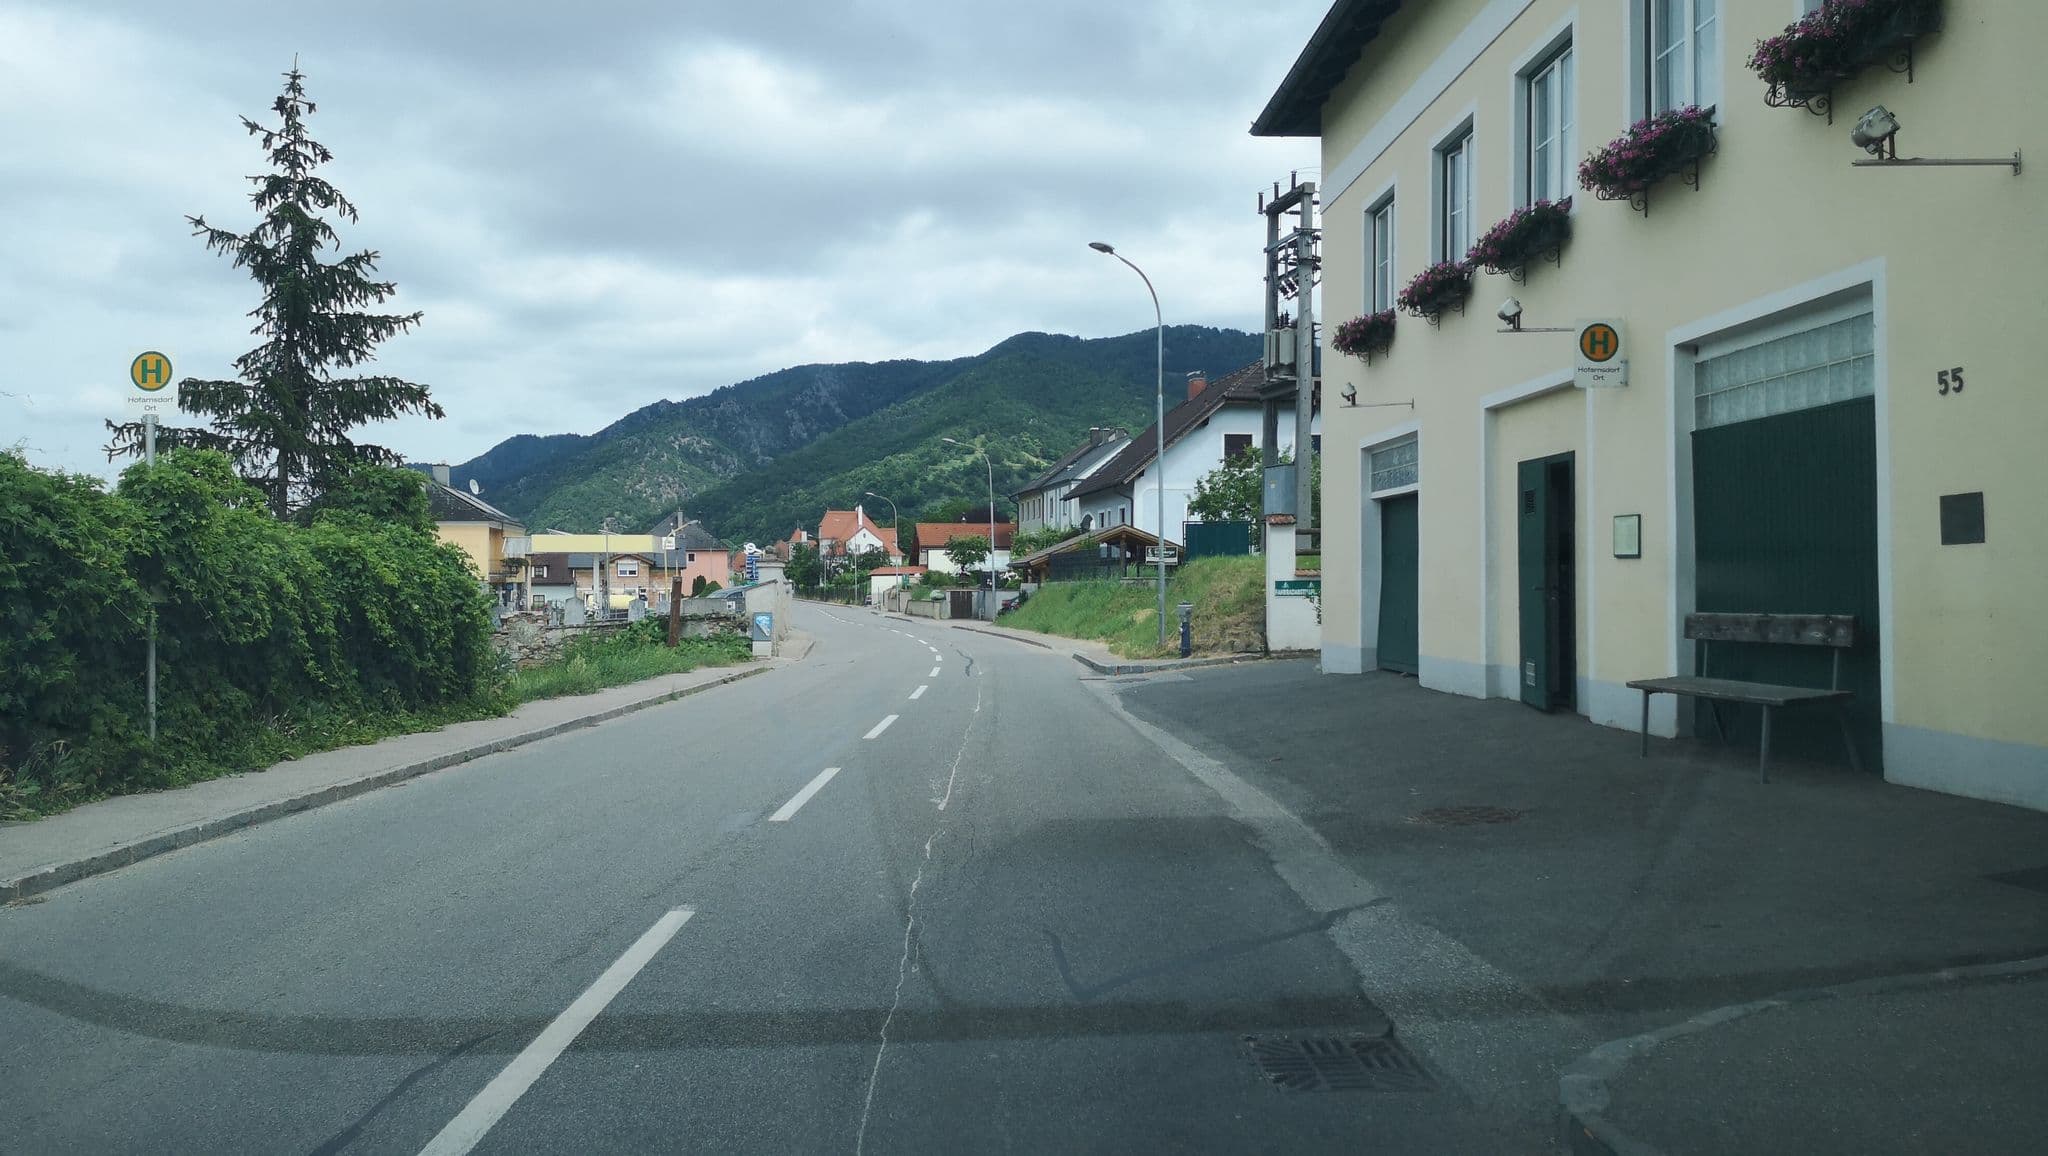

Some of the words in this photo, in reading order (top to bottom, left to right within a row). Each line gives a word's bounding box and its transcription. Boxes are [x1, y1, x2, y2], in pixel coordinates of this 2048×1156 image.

[1590, 331, 1609, 354] H
[141, 359, 162, 384] H
[1937, 366, 1964, 396] 55
